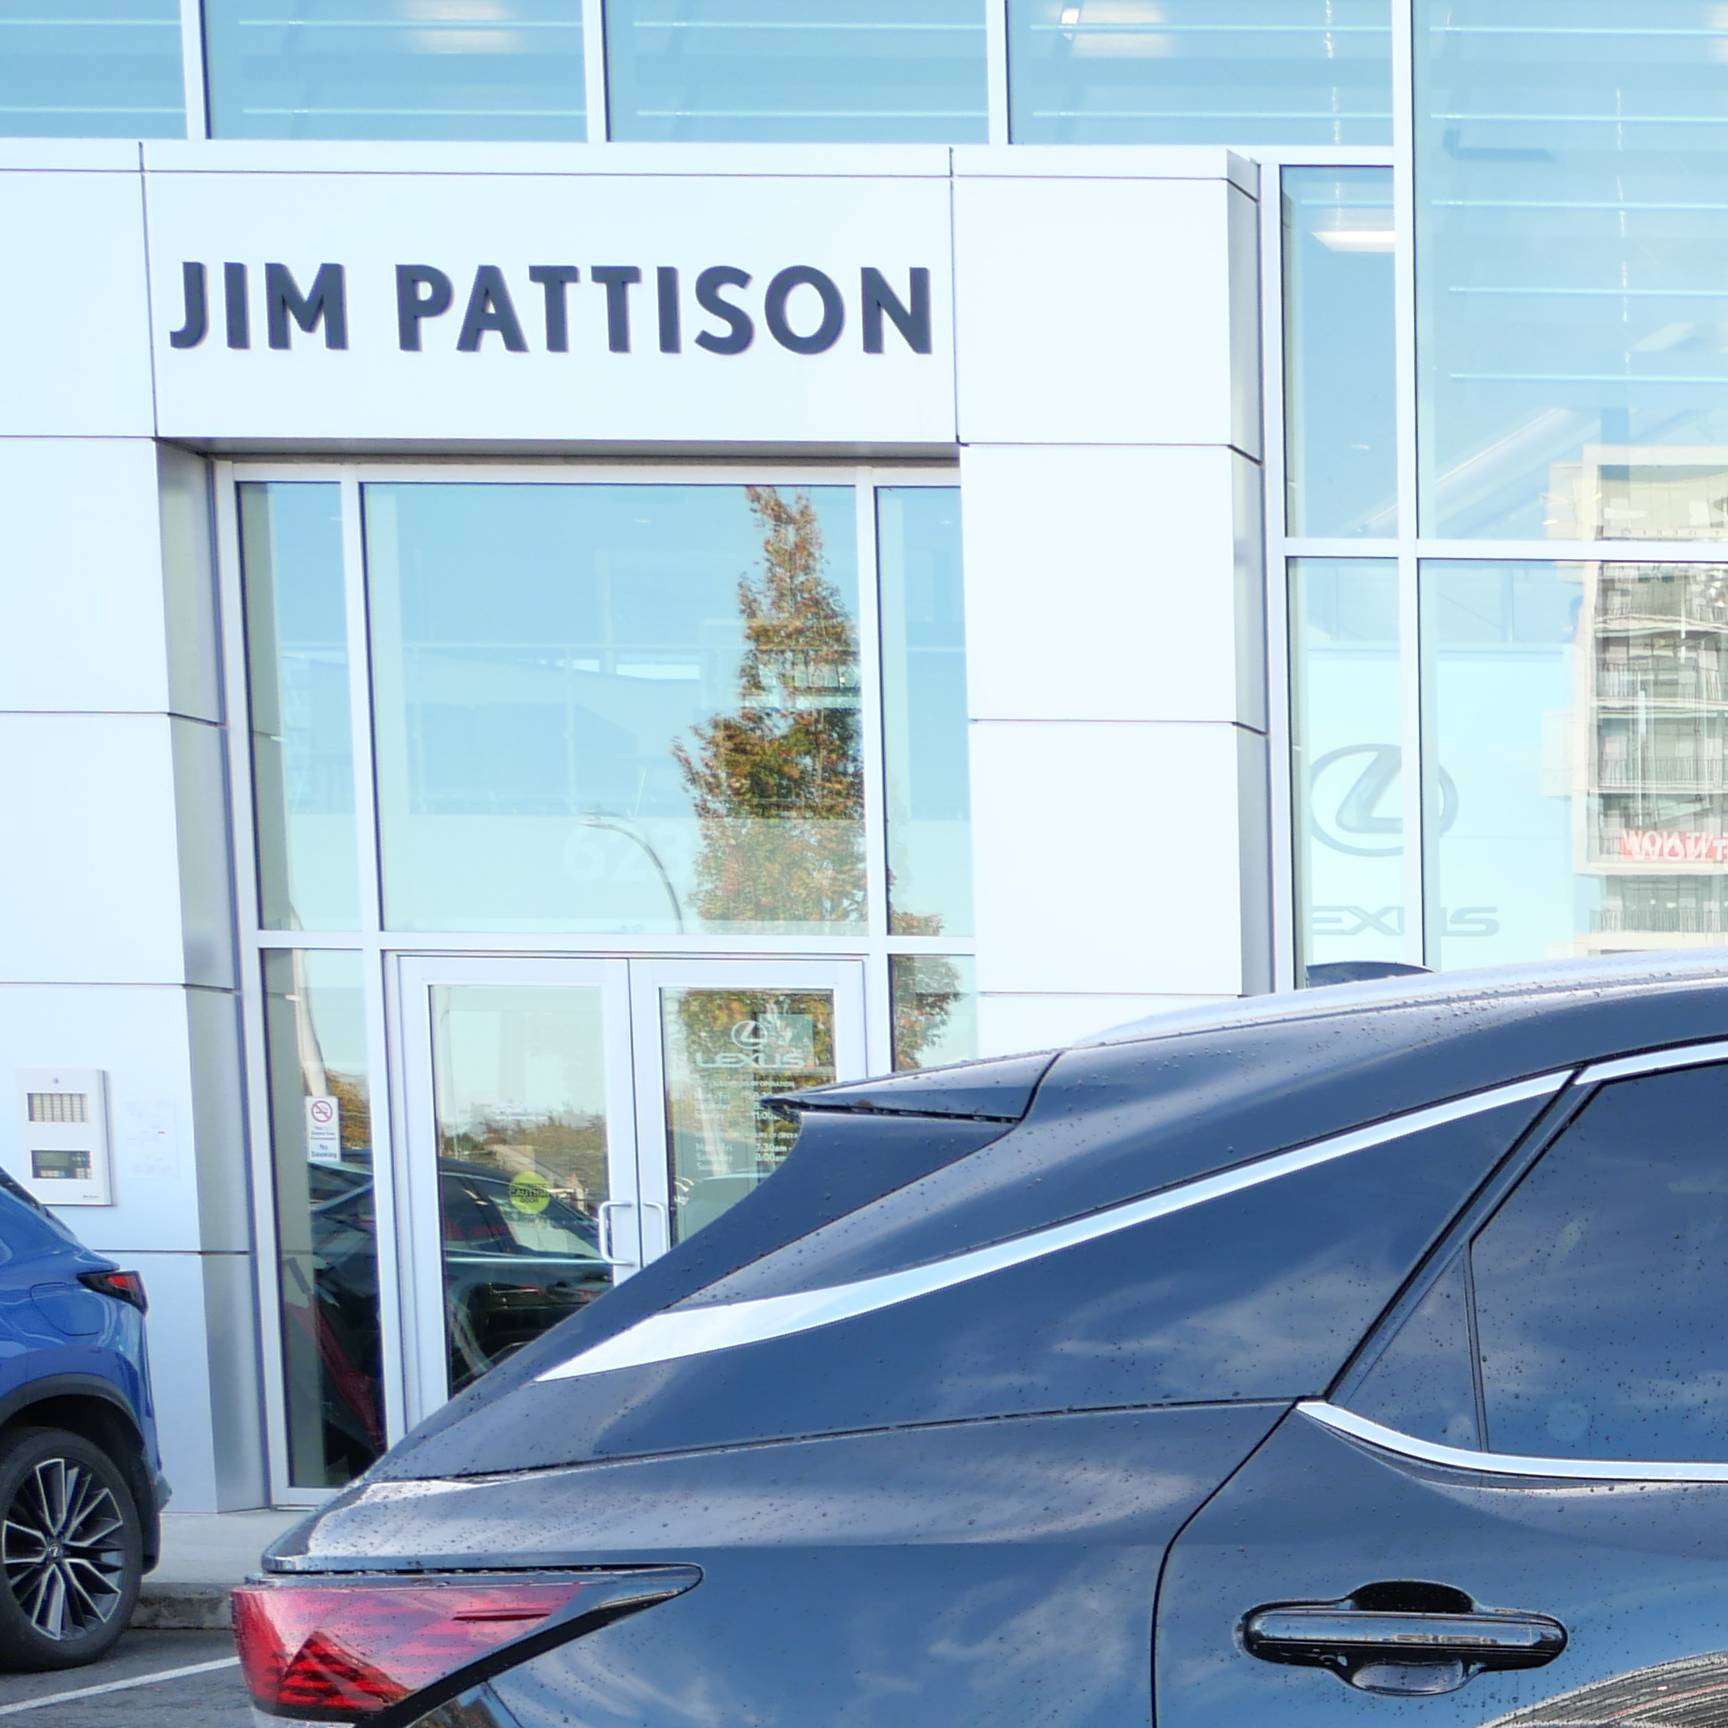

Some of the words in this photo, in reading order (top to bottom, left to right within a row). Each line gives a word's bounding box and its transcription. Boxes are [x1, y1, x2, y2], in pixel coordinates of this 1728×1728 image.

[170, 261, 348, 350] JIM
[395, 264, 933, 354] PATTISON
[697, 1051, 805, 1068] LEXUS
